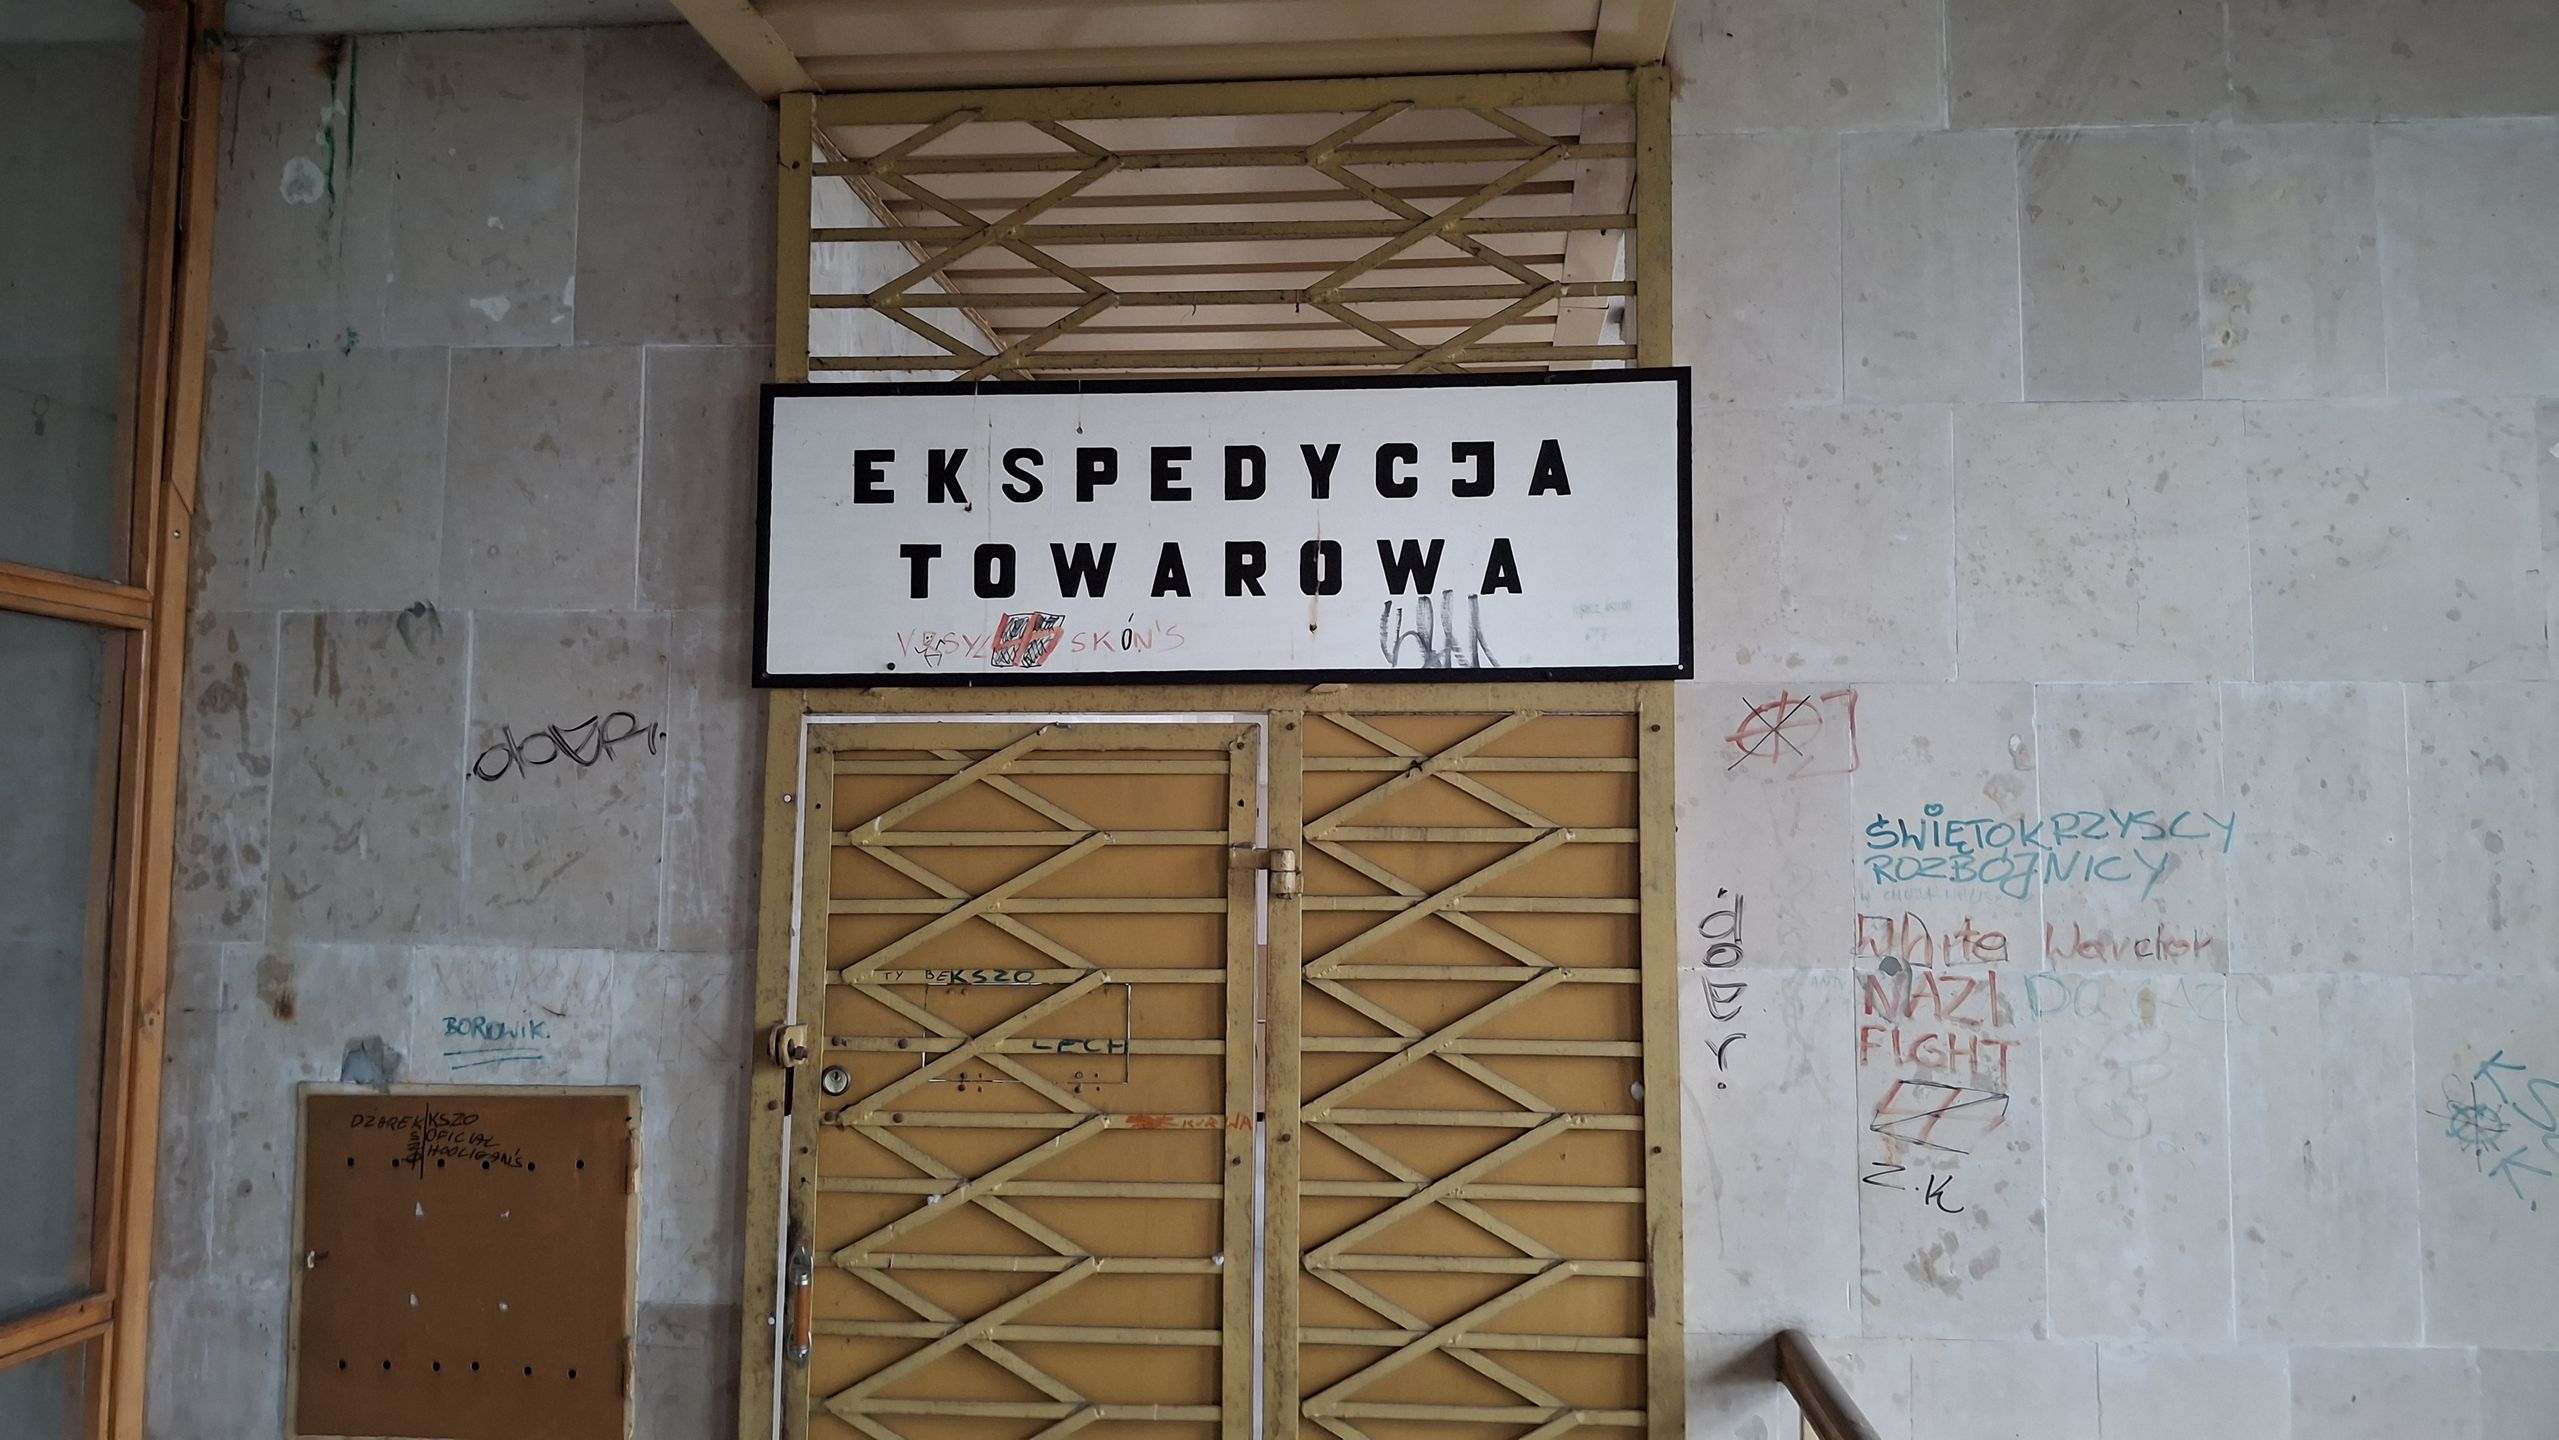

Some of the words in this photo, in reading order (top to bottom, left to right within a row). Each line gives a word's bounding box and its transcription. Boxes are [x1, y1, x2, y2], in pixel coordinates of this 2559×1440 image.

[852, 438, 1572, 503] EKSPEDYCJA
[899, 537, 1524, 598] TOWAROWA
[1864, 970, 1999, 1027] NAZI
[1859, 1027, 2020, 1083] FIGHT
